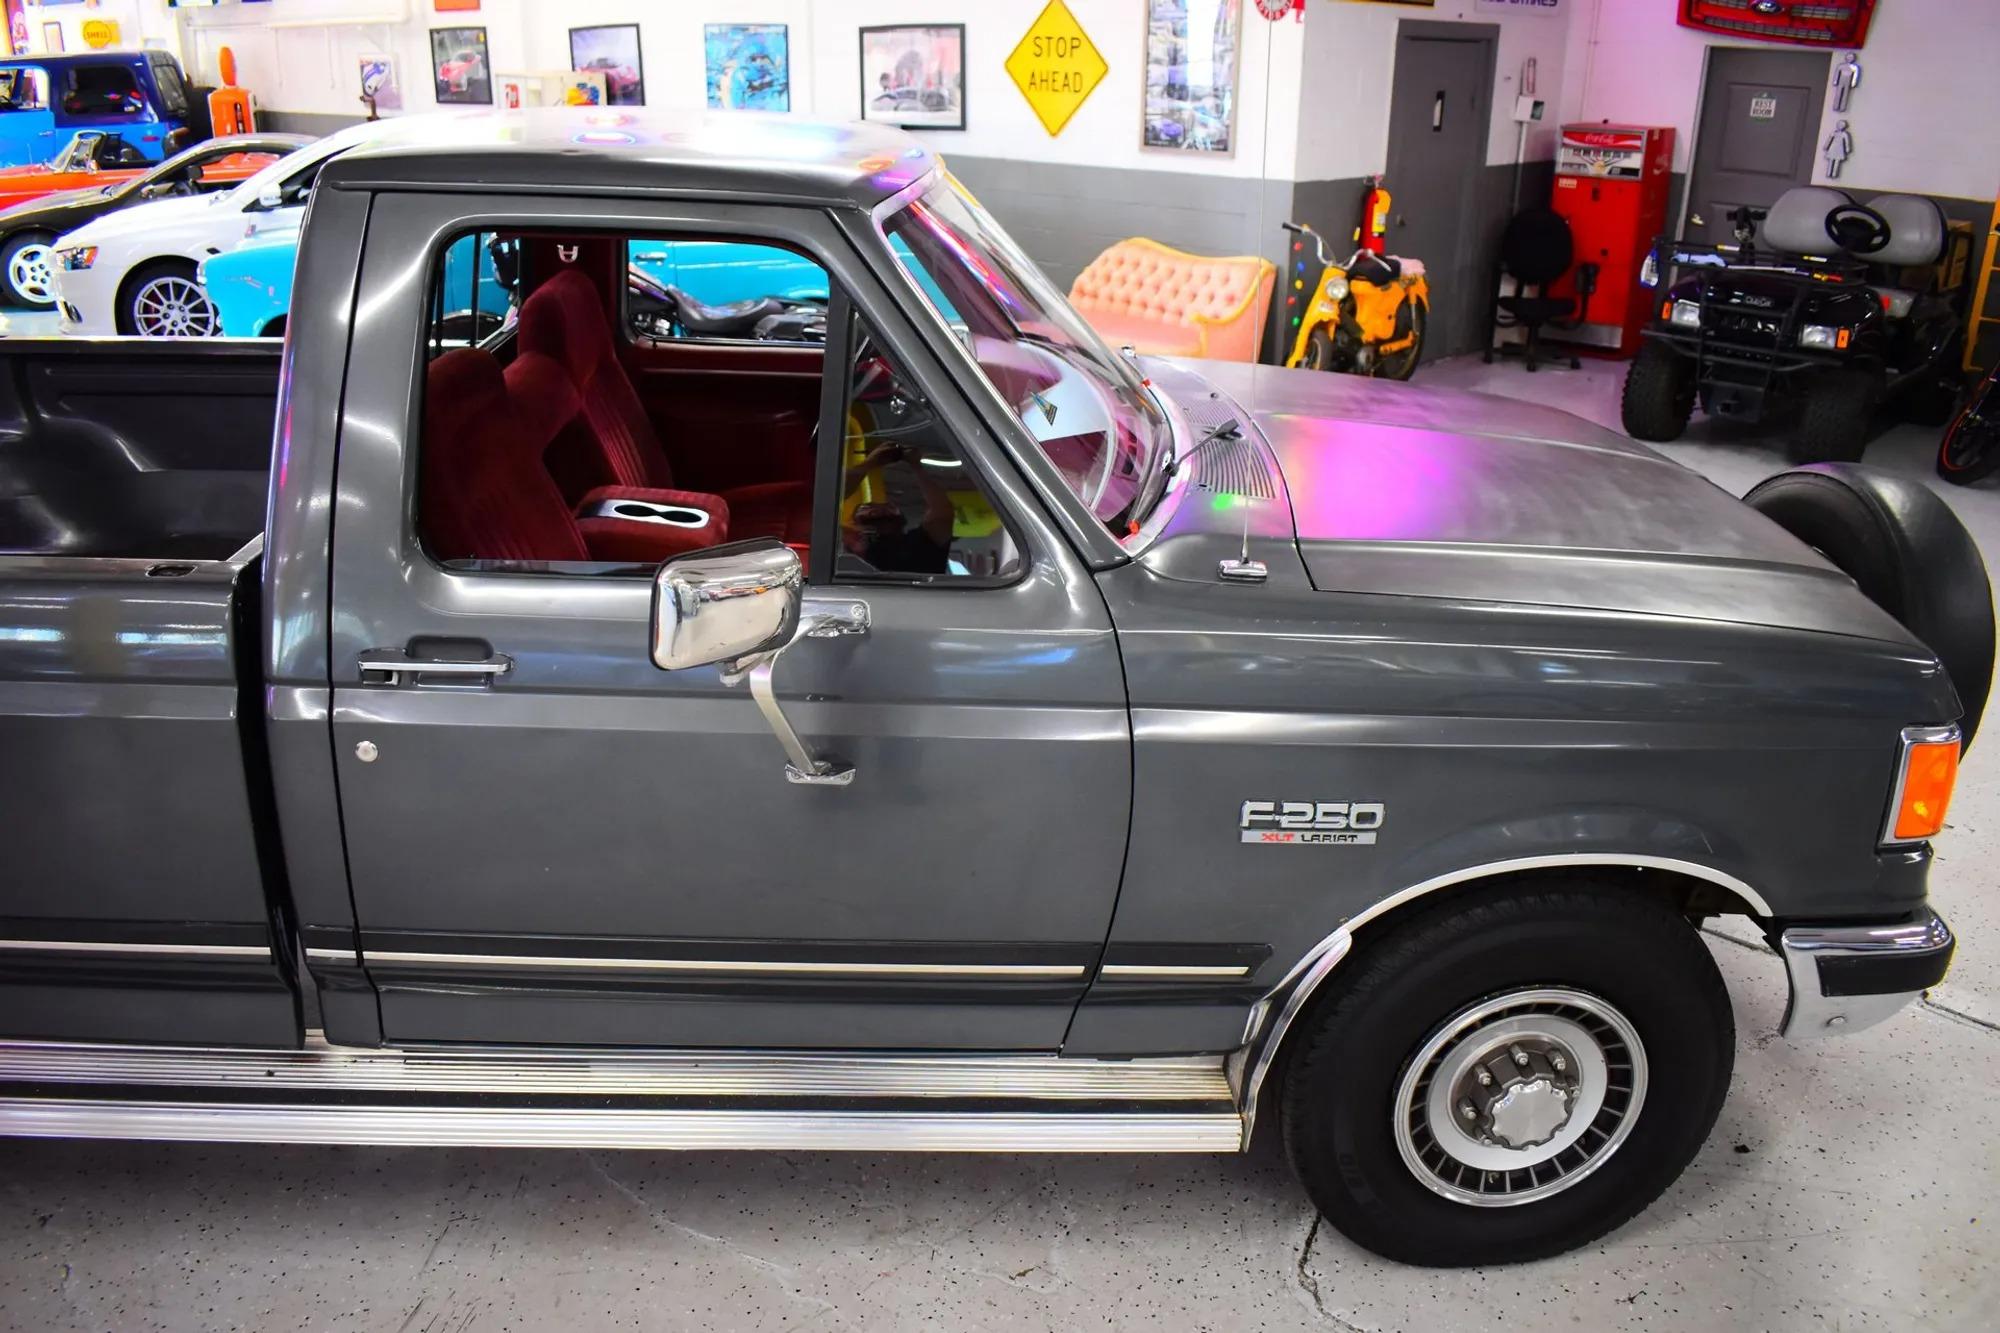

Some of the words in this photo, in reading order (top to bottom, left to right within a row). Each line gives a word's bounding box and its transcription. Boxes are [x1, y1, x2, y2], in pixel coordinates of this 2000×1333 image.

[1033, 36, 1081, 58] STOP
[1028, 70, 1083, 93] AHEAD
[1240, 800, 1385, 829] F-250
[1262, 832, 1295, 842] XLT
[1301, 833, 1358, 843] LARIAT
